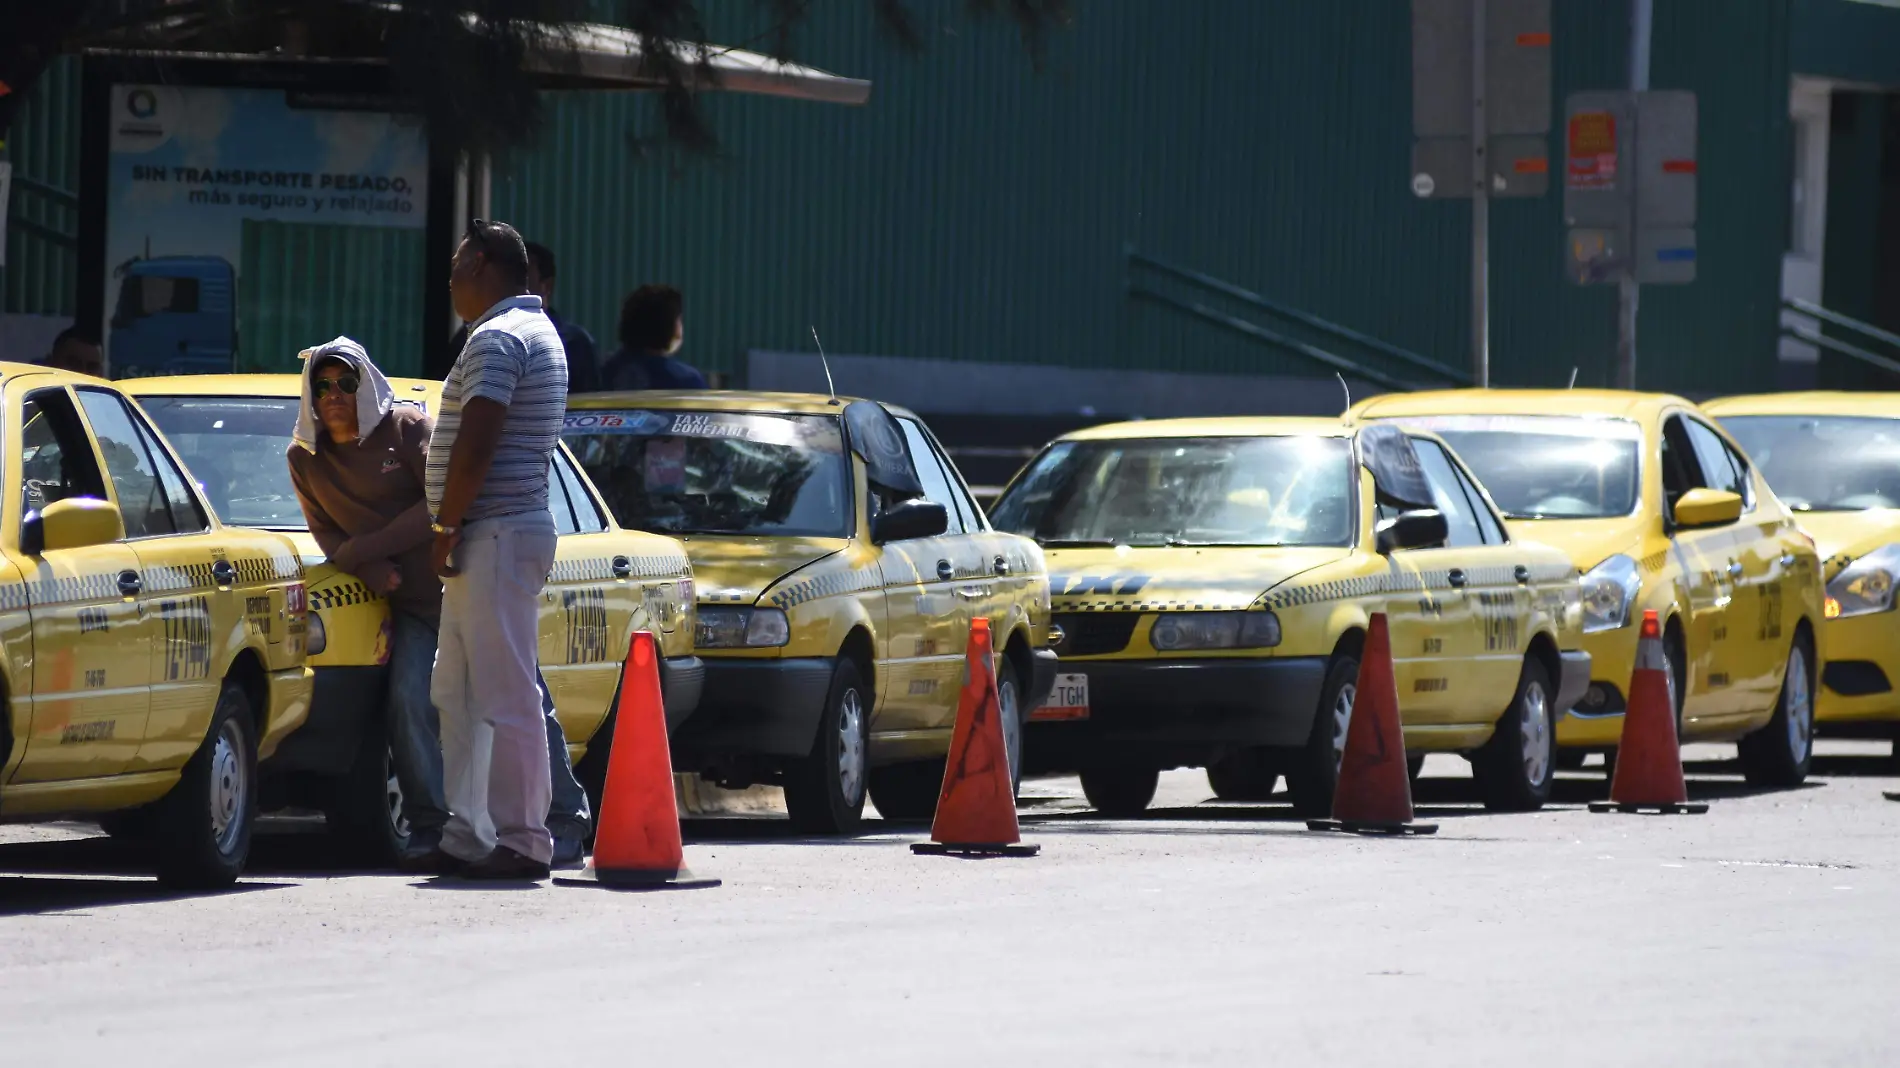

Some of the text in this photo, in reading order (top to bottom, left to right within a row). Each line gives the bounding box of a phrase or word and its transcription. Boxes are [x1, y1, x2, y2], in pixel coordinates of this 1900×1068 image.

[132, 164, 412, 195] SIN TRANSPORTE PESADO,
[188, 187, 413, 216] más seguro y relajado
[675, 414, 709, 425] TAXI
[1044, 686, 1085, 706] -TGH
